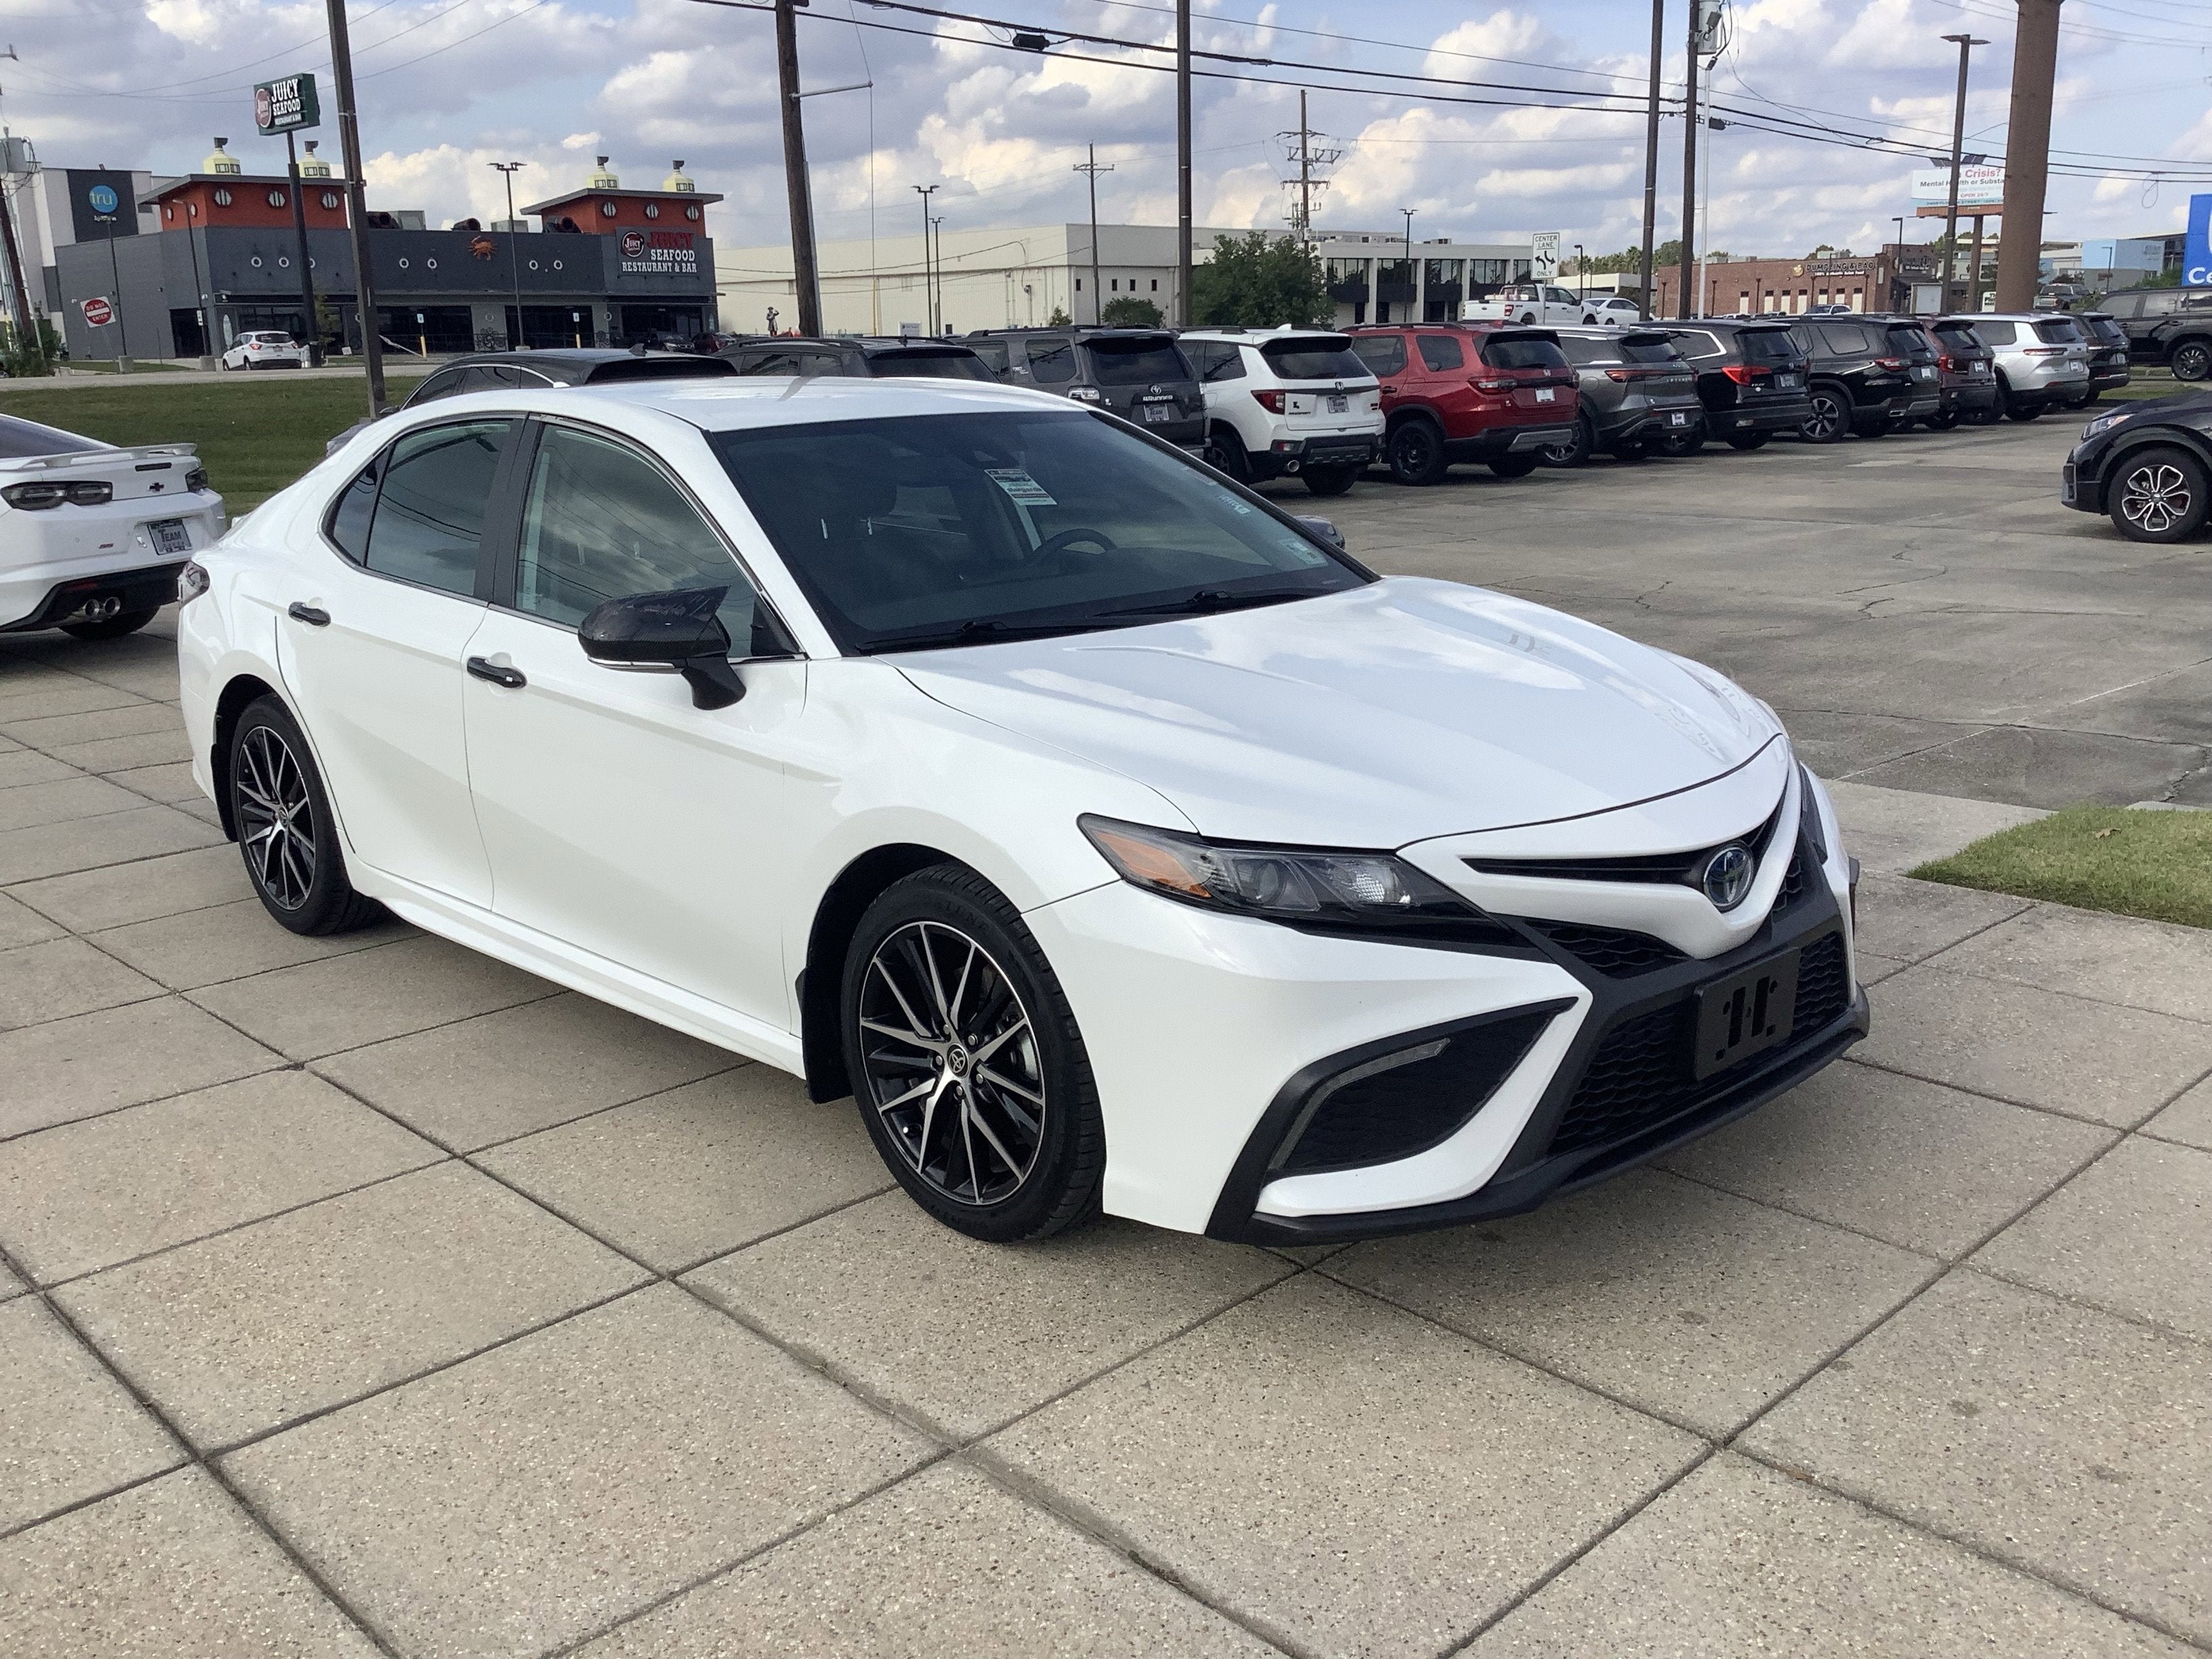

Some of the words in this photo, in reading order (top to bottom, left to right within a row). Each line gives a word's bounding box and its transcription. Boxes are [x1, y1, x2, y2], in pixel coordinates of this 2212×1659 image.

[271, 79, 298, 102] JUICY
[272, 98, 300, 116] SEAFOOD
[1965, 168, 2001, 178] Crisis?
[90, 191, 112, 205] tru
[647, 232, 694, 249] JUICY
[651, 249, 695, 262] SEAFOOD
[622, 262, 672, 272] RESTAURANT
[674, 262, 680, 272] &
[682, 262, 697, 273] BAR
[158, 529, 182, 542] TEAM
